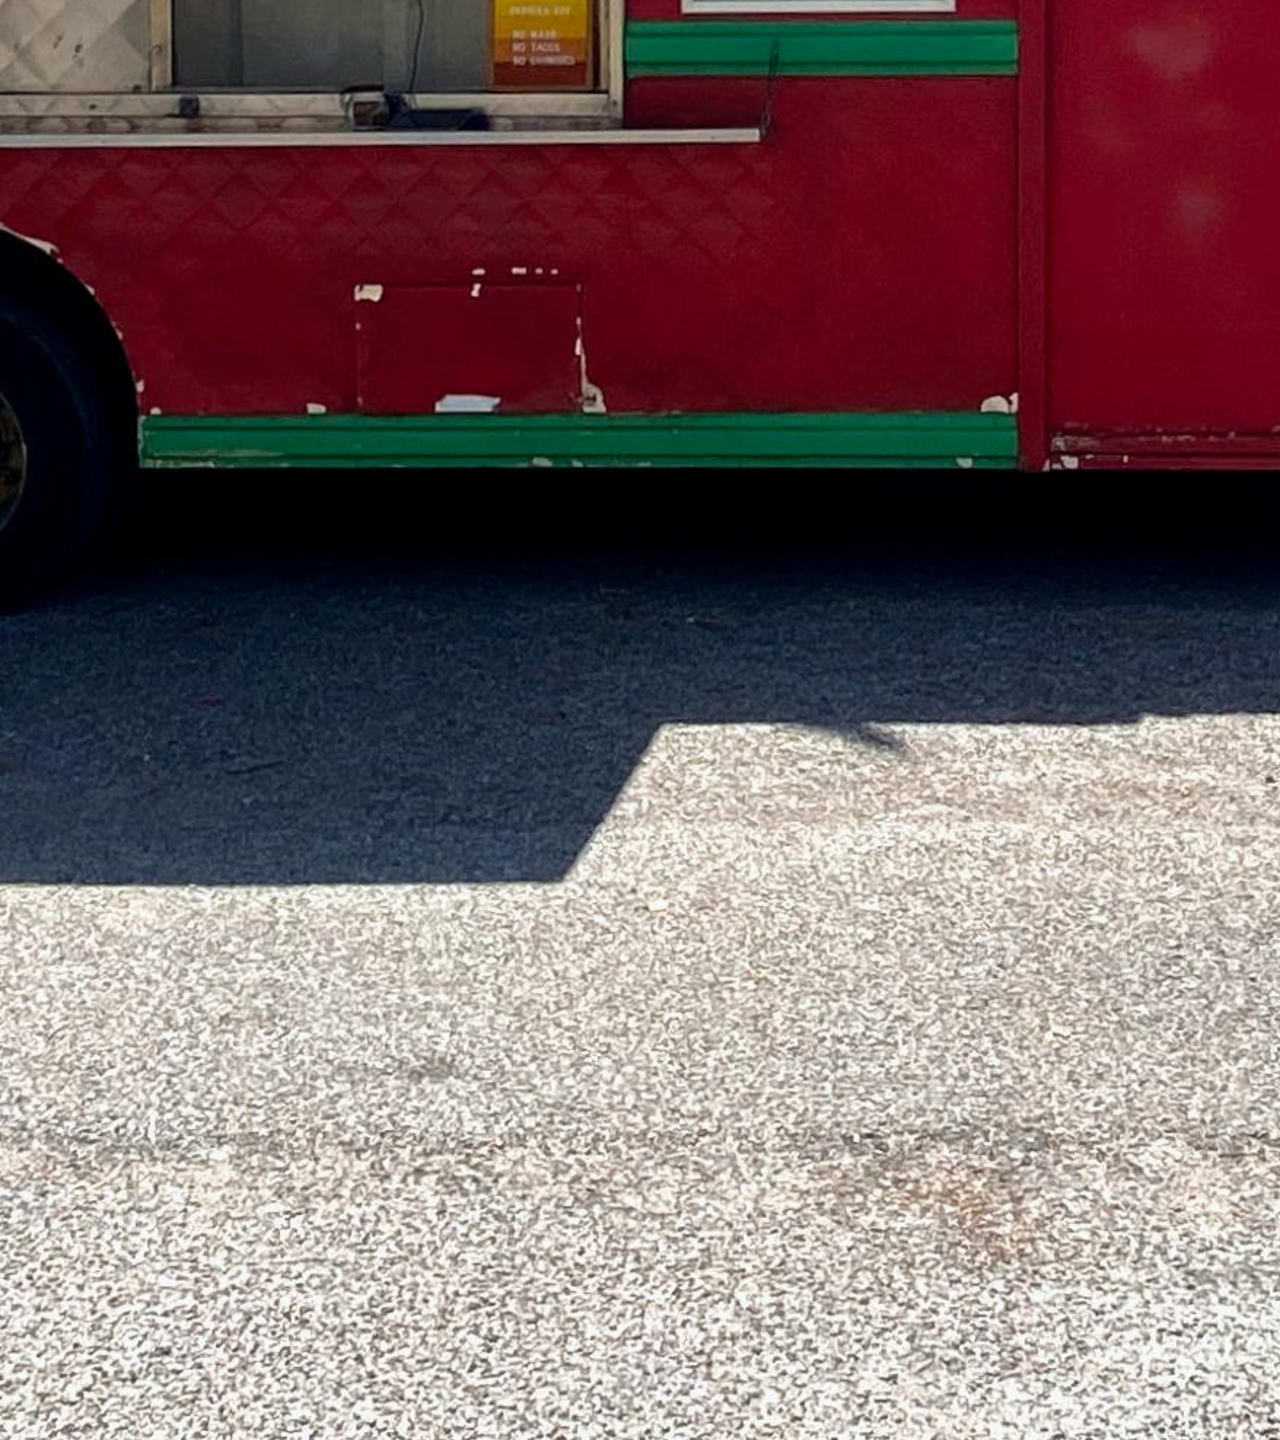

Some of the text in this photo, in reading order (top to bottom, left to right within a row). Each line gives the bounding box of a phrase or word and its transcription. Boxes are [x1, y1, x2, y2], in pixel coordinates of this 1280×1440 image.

[512, 29, 525, 39] NO
[512, 42, 526, 53] NO
[513, 55, 527, 66] NO
